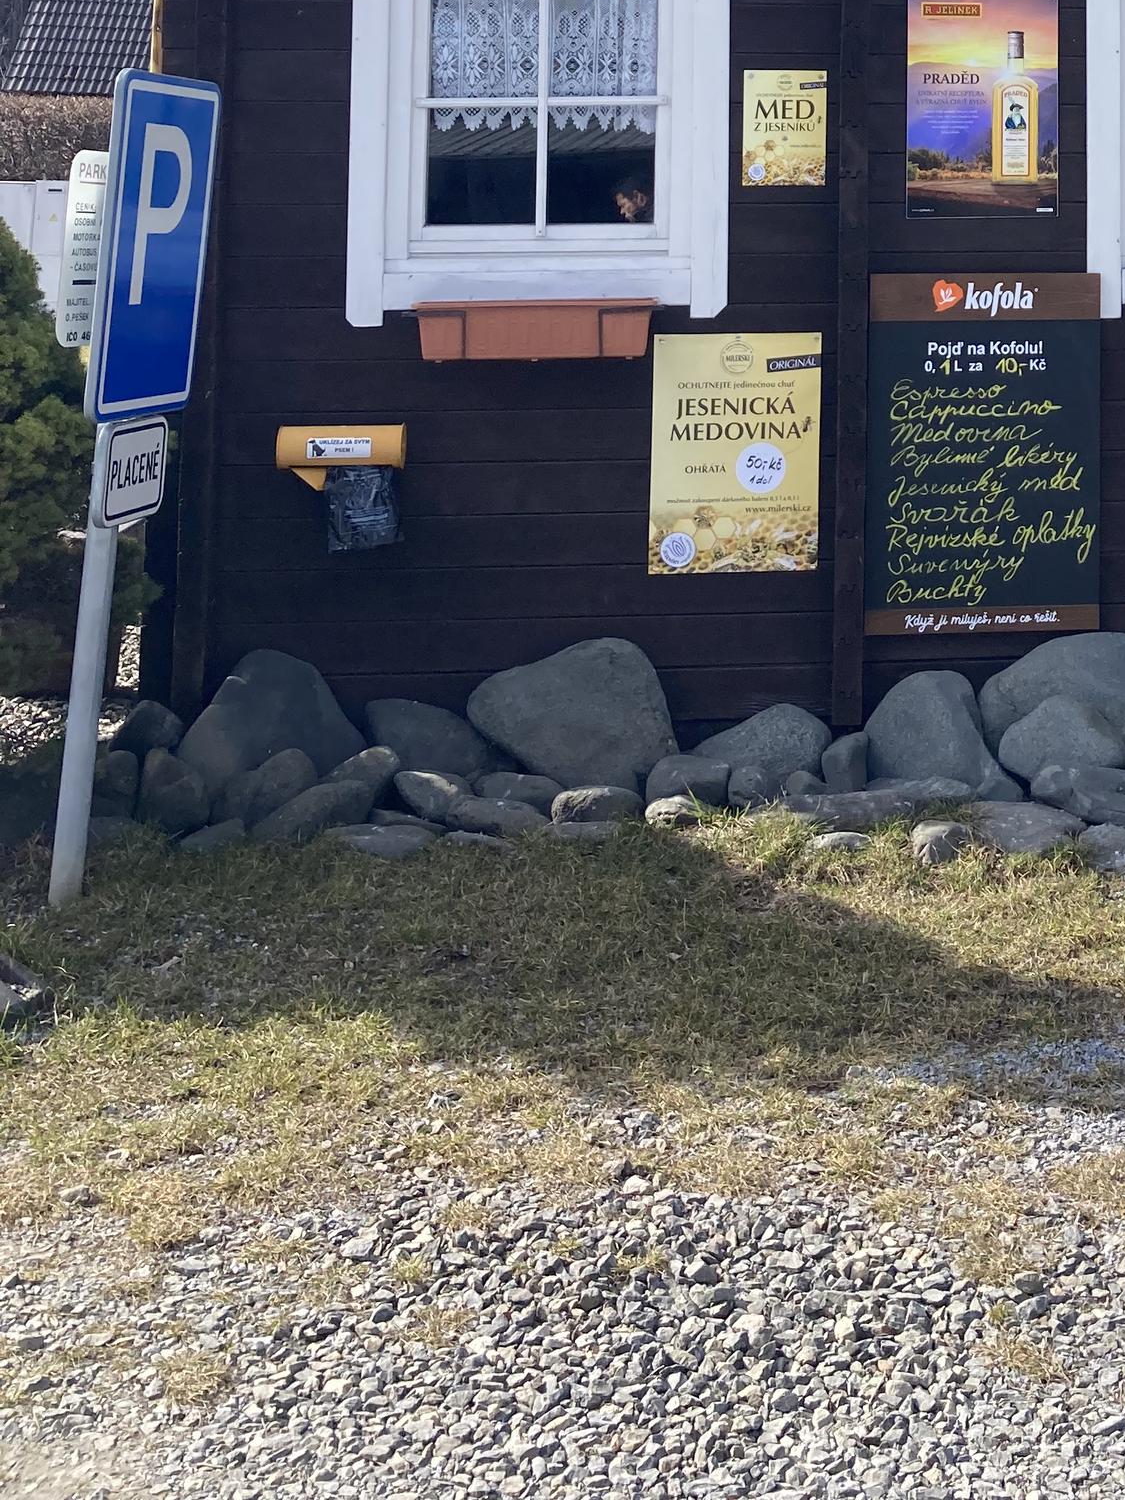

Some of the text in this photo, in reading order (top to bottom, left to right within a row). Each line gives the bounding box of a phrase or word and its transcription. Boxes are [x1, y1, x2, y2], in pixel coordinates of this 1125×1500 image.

[923, 70, 980, 84] PRADĚD
[754, 99, 815, 120] MED
[753, 121, 761, 132] Z
[129, 123, 192, 306] P
[964, 282, 1034, 317] kofola
[927, 341, 1043, 359] Pojď na Kofolu!
[769, 355, 817, 371] ORIGINÁL
[954, 360, 962, 372] L
[968, 362, 983, 372] za
[1029, 358, 1047, 371] Kč
[677, 379, 796, 390] OCHUTNEJTE jedinečnou chuť
[676, 391, 796, 420] JESENICKÁ
[670, 421, 802, 442] MEDOVINA
[110, 442, 160, 491] PLACENÉ
[684, 462, 727, 475] OHŘÁTÁ
[904, 613, 935, 633] Když
[950, 611, 992, 631] miluješ,
[994, 612, 1017, 624] není
[1019, 613, 1032, 623] co
[1034, 609, 1061, 623] řešit.
